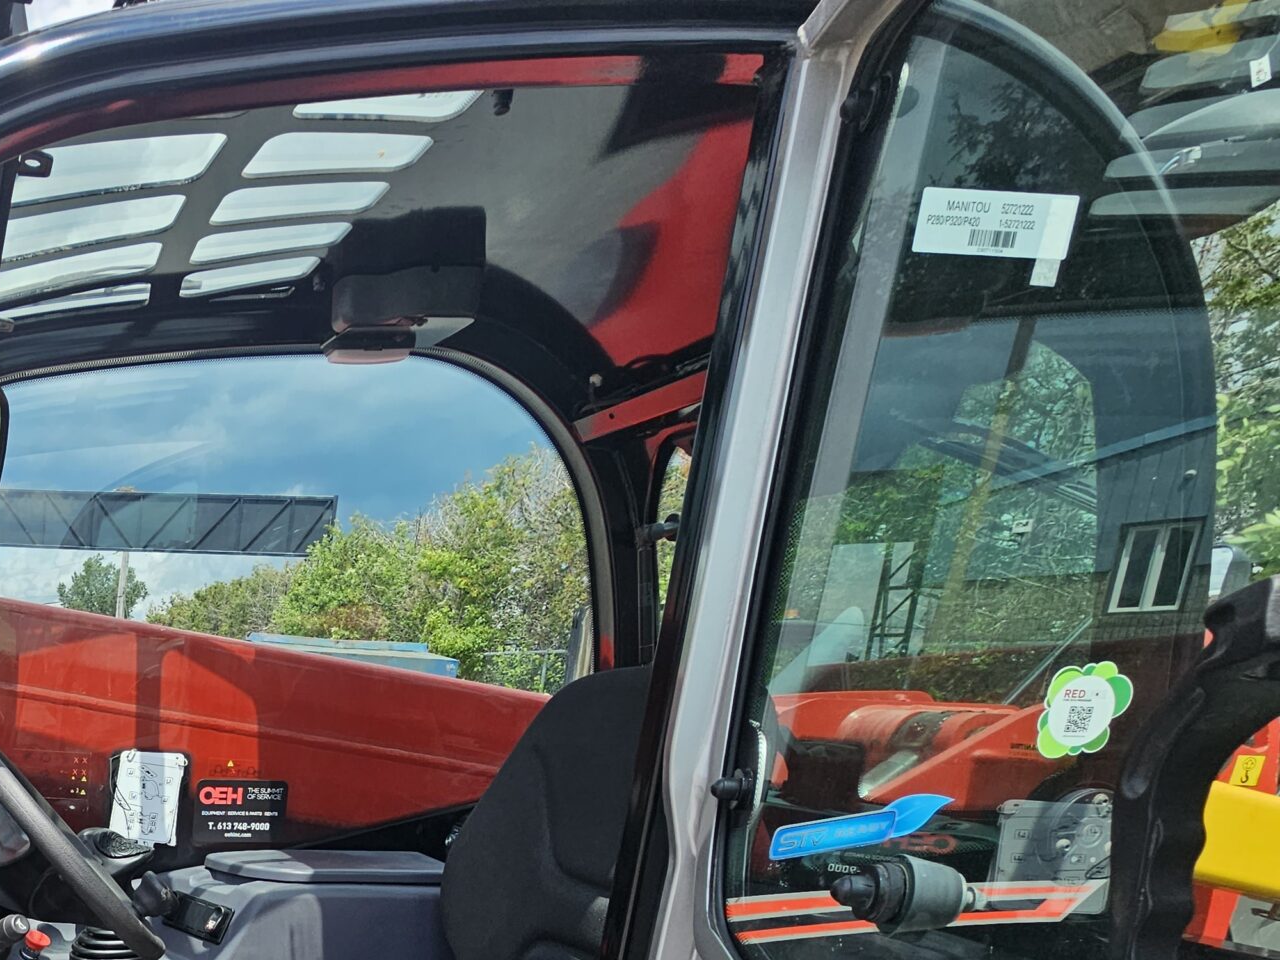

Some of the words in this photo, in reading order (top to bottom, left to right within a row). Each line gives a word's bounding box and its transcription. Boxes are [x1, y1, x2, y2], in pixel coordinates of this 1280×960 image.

[946, 200, 991, 213] MANITOU
[1001, 203, 1034, 215] 52721222
[926, 214, 981, 227] P280/P320/P420
[1064, 689, 1086, 698] RED
[199, 786, 243, 805] OEH
[208, 822, 216, 830] T.
[217, 822, 232, 831] 613
[233, 822, 270, 831] 748-9000
